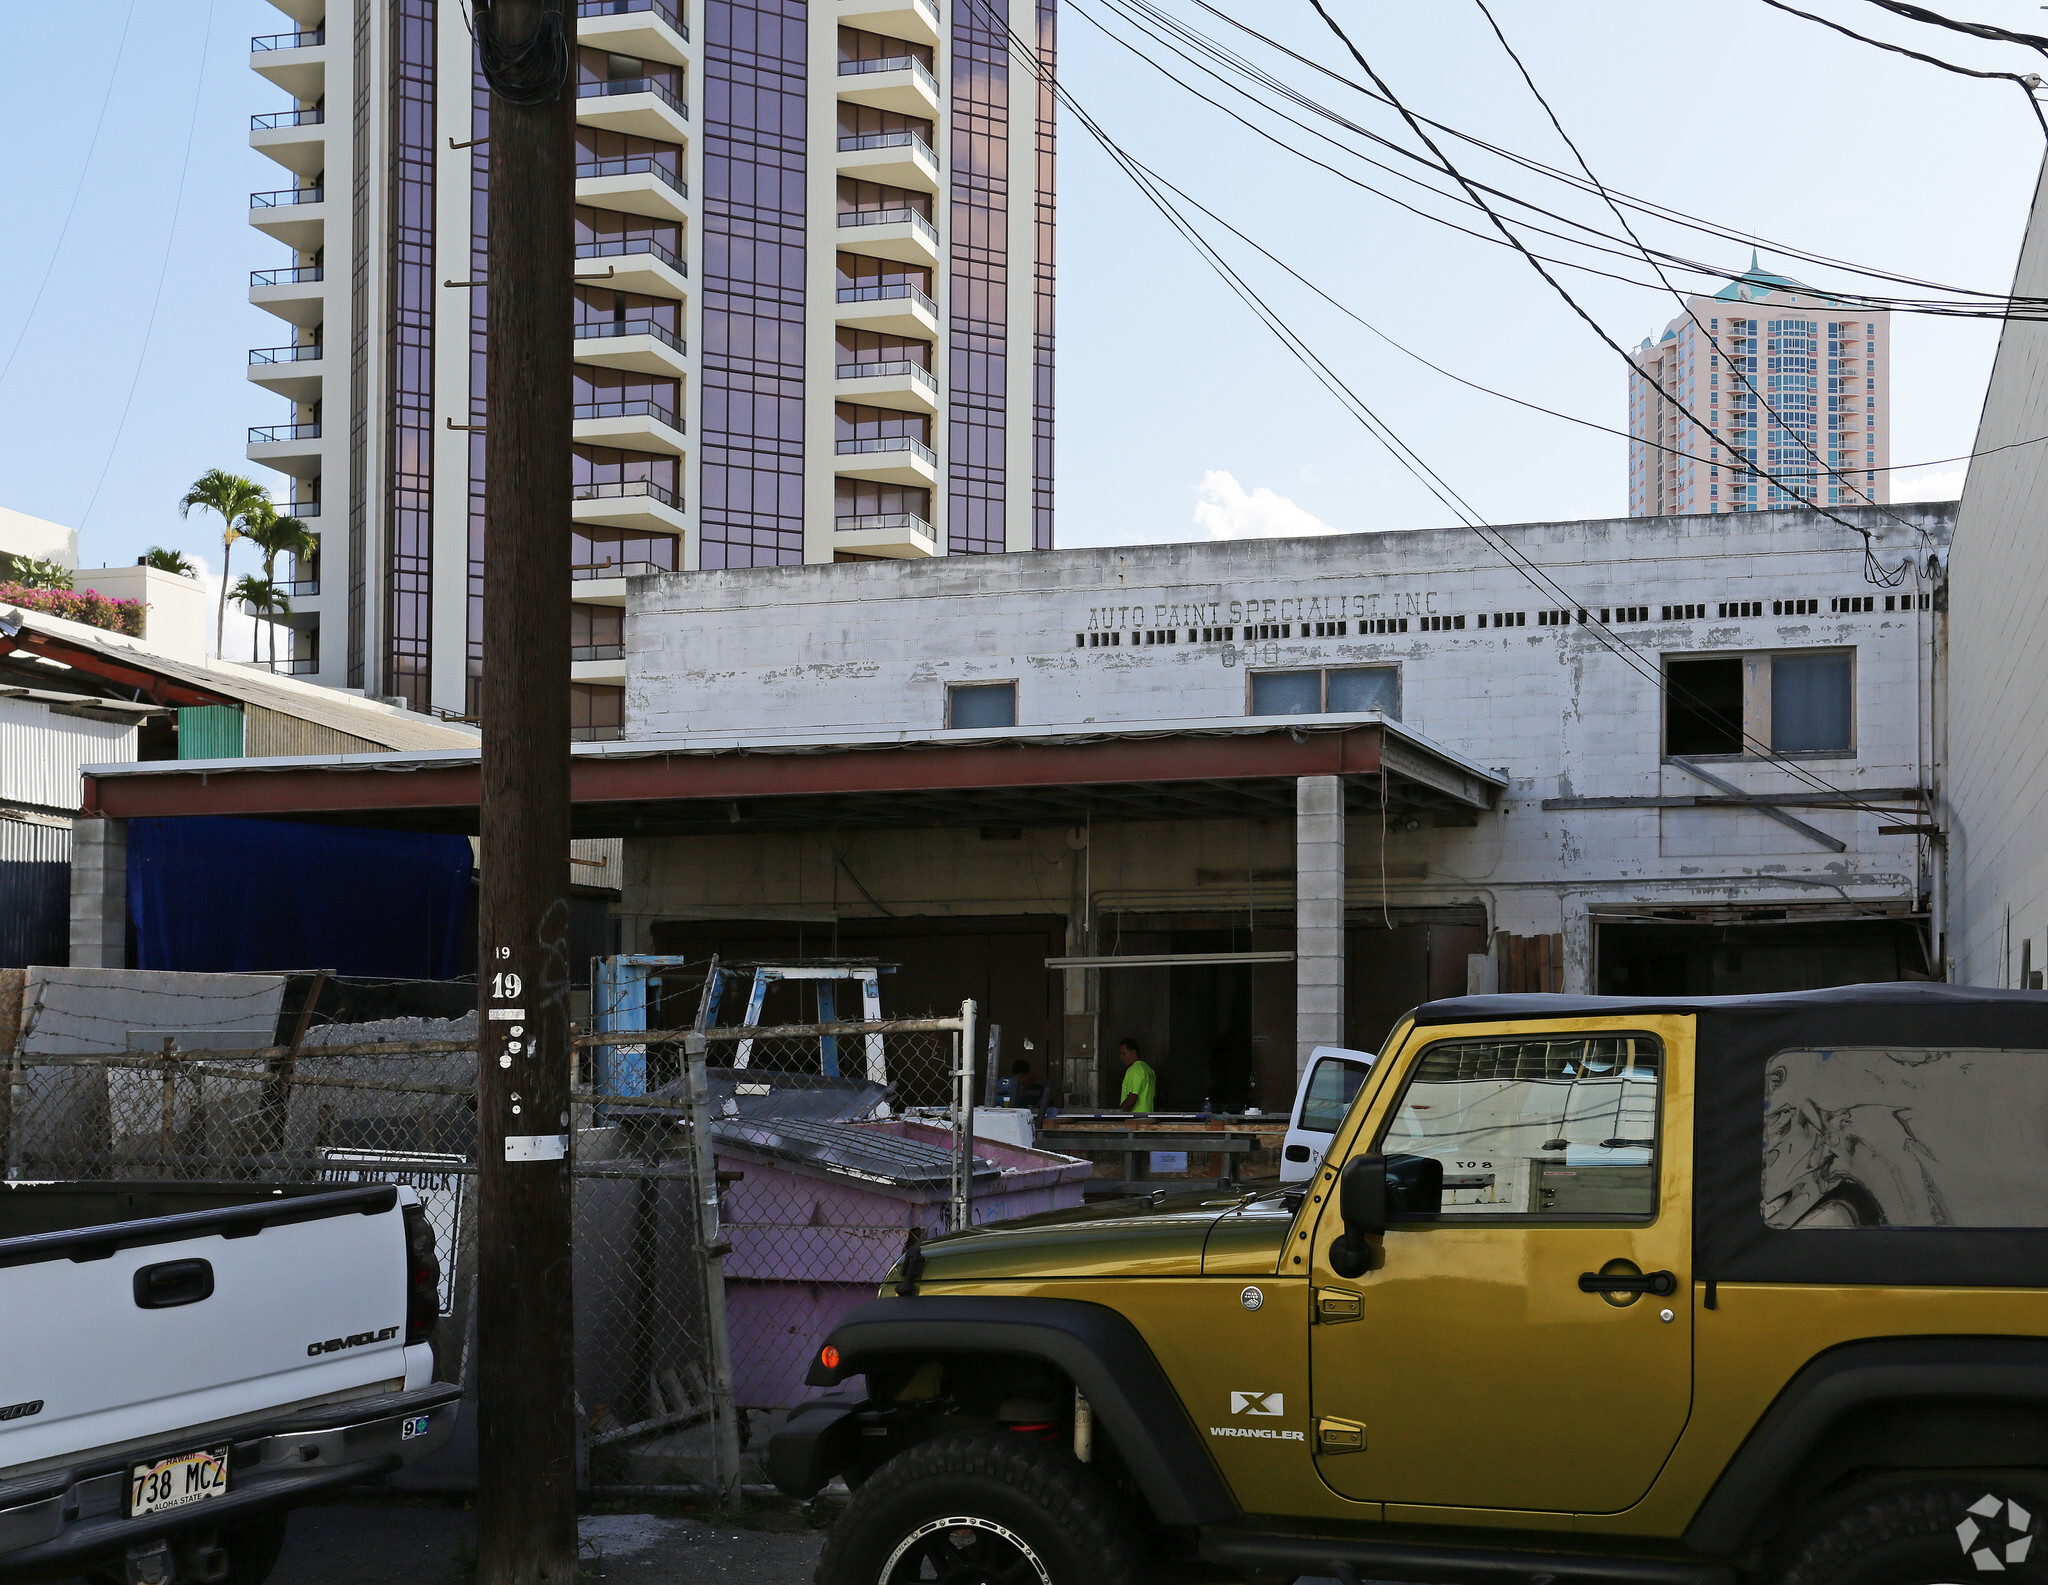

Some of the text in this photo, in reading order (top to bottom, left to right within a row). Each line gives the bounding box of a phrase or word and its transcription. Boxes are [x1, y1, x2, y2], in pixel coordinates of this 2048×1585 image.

[1088, 606, 1145, 630] AUTO
[1155, 602, 1220, 627] PAINT
[496, 946, 511, 959] 19
[492, 972, 522, 998] 19
[308, 1326, 400, 1356] CHEVROLET
[1210, 1427, 1304, 1441] WRANGLER
[134, 1457, 225, 1506] 738 MCZ
[154, 1493, 202, 1511] ALOHA STATE
